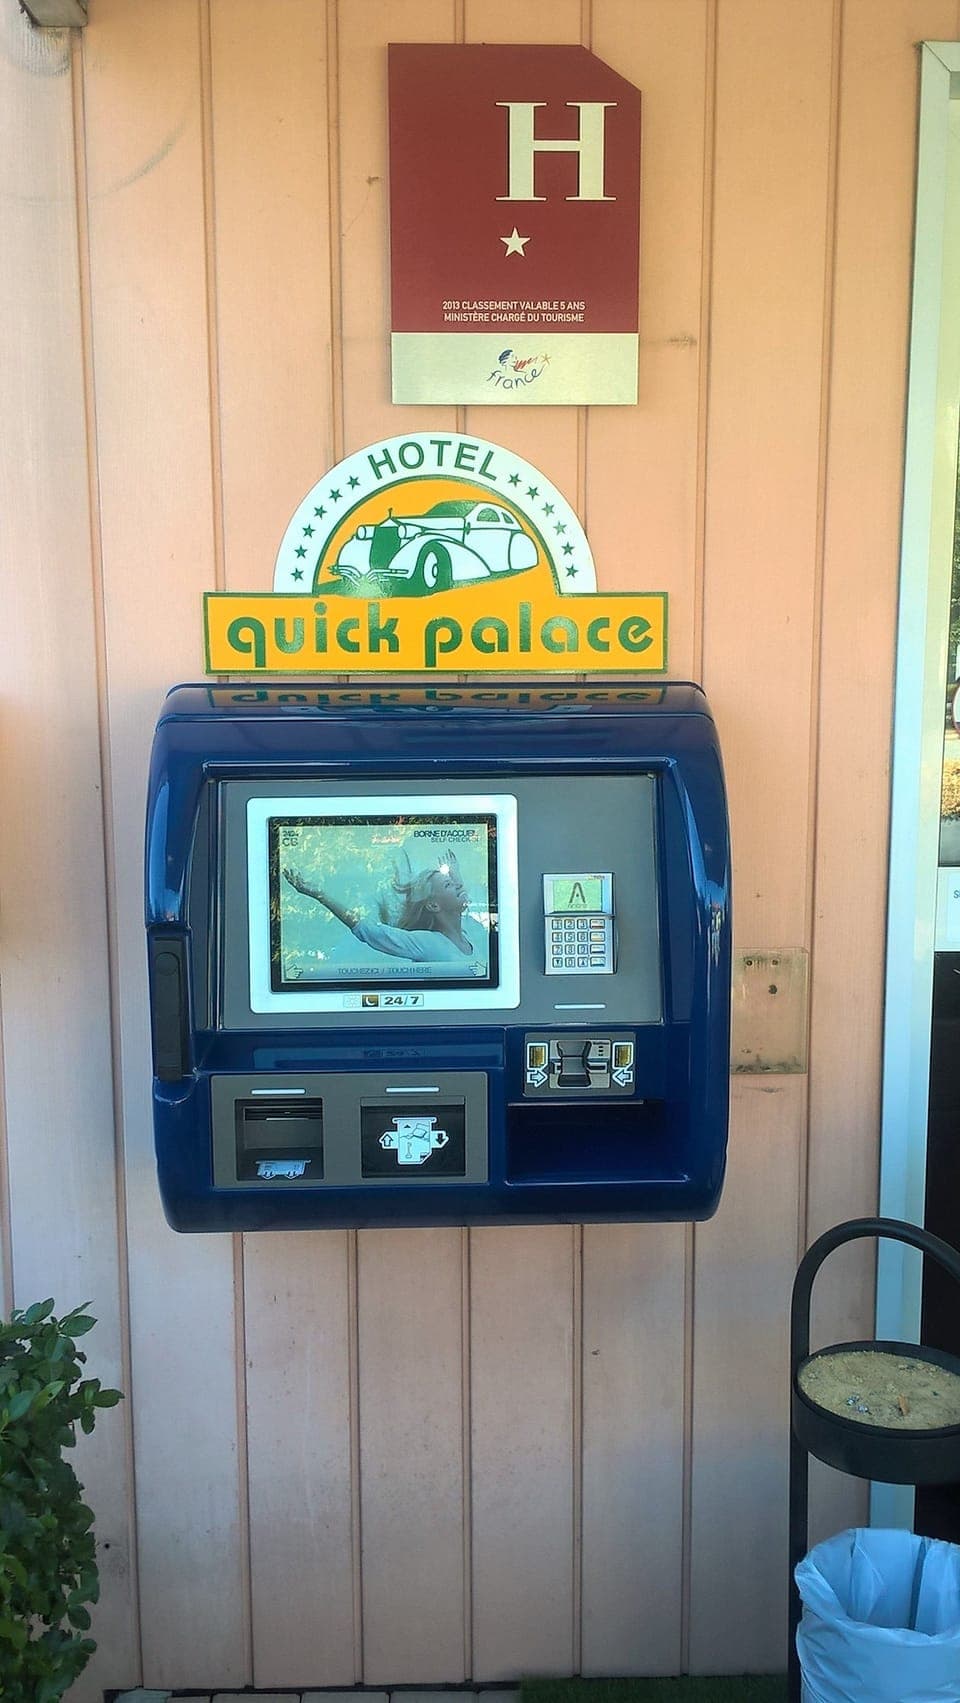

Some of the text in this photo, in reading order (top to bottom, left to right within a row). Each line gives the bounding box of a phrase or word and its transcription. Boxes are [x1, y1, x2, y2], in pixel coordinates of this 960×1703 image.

[495, 102, 617, 201] H
[442, 301, 586, 310] 2013 CLASSEMENT VALABLE 5 ANS
[444, 311, 584, 322] MINISTÈRE CHARGÉ DU TOURISME
[368, 440, 497, 481] HOTEL
[227, 601, 654, 668] quick palace
[953, 889, 960, 899] S
[384, 995, 419, 1006] 24/7
